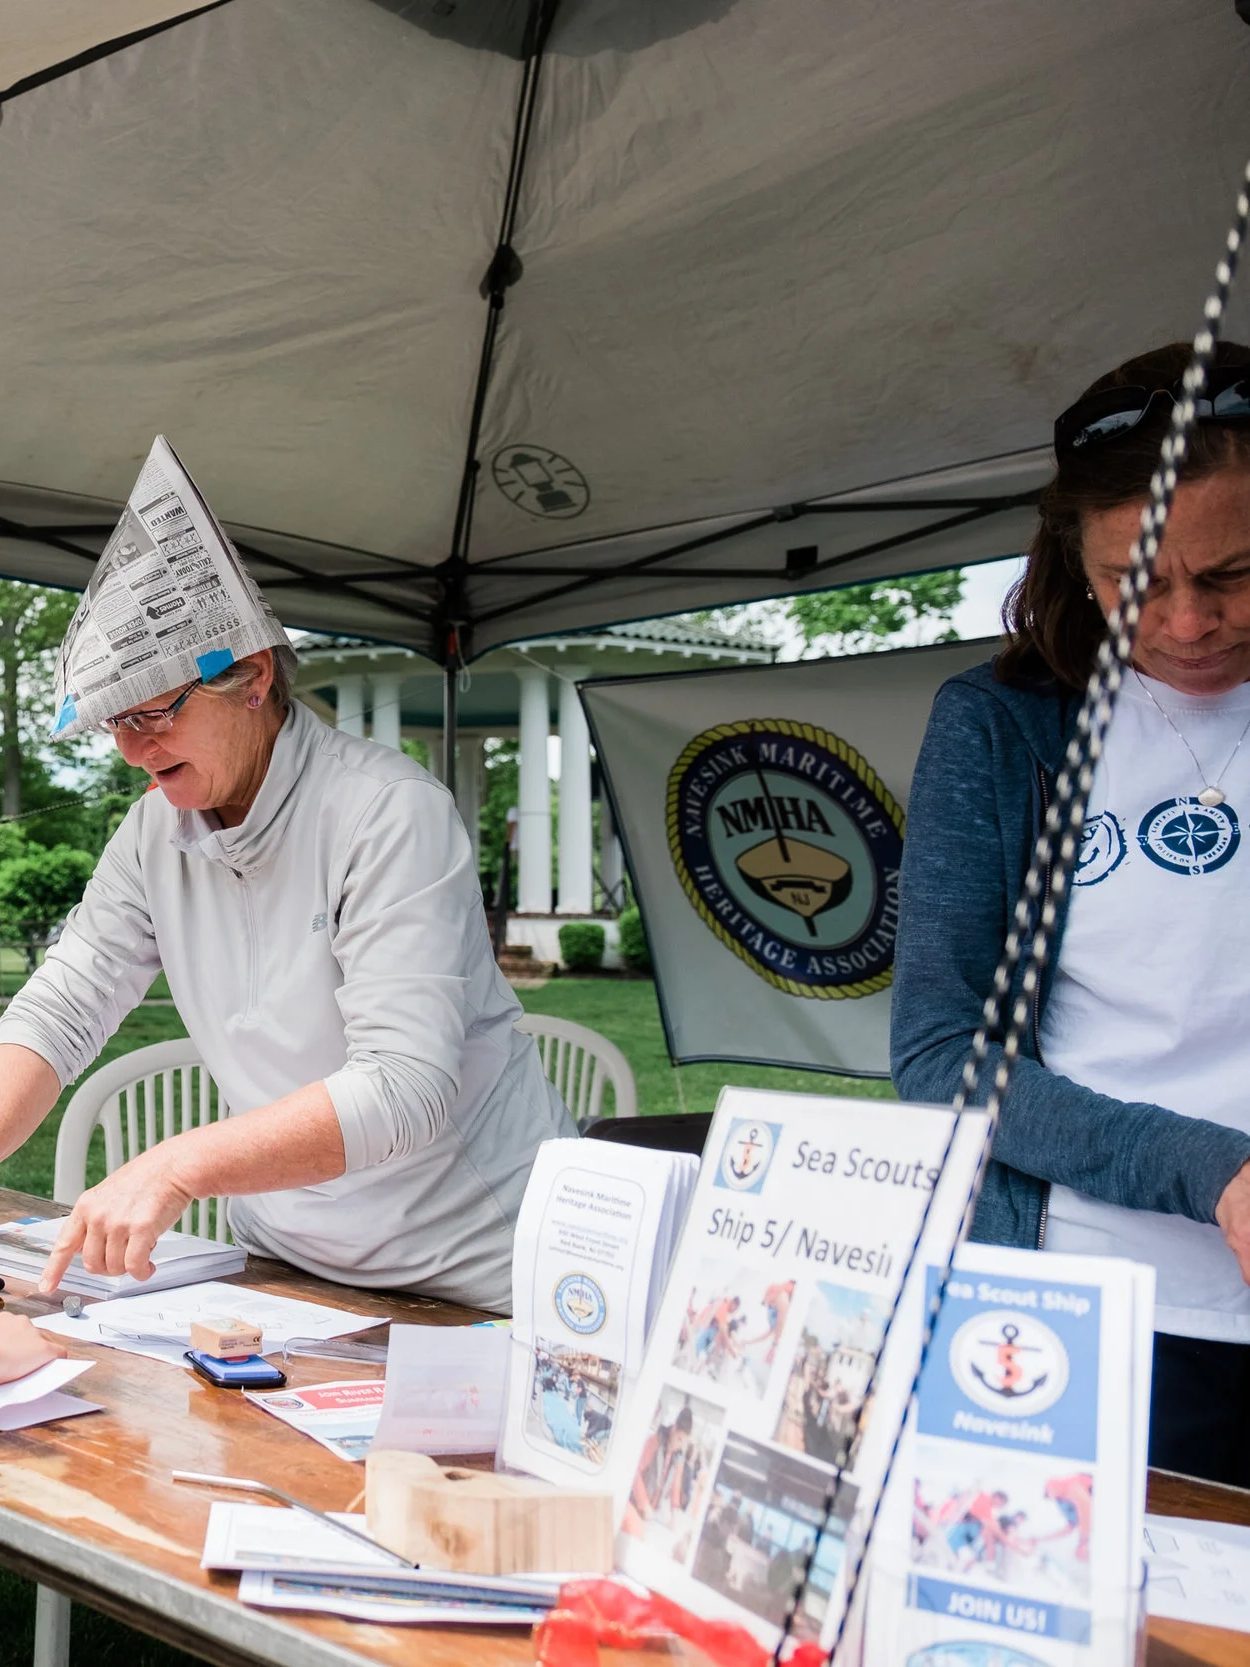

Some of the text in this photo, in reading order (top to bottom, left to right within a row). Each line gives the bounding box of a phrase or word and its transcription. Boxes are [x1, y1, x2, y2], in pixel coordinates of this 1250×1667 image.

[150, 506, 186, 528] WANTED
[173, 562, 194, 578] TODAY
[196, 555, 212, 568] CALL
[158, 597, 183, 614] Homes
[107, 624, 129, 640] HOUSE
[126, 617, 143, 630] OPEN
[685, 742, 889, 839] NAVESINK MARITIME
[1178, 797, 1188, 806] N
[715, 795, 837, 839] NMHA
[1192, 865, 1201, 875] S
[695, 865, 901, 976] HERITAGE ASSOCIATION
[791, 1140, 942, 1192] Sea Scouts
[707, 1208, 755, 1250] Ship
[978, 1283, 1038, 1309] Scout
[1042, 1290, 1092, 1318] Ship
[952, 1410, 1054, 1445] Navesink
[947, 1591, 1047, 1633] JOIN US!
